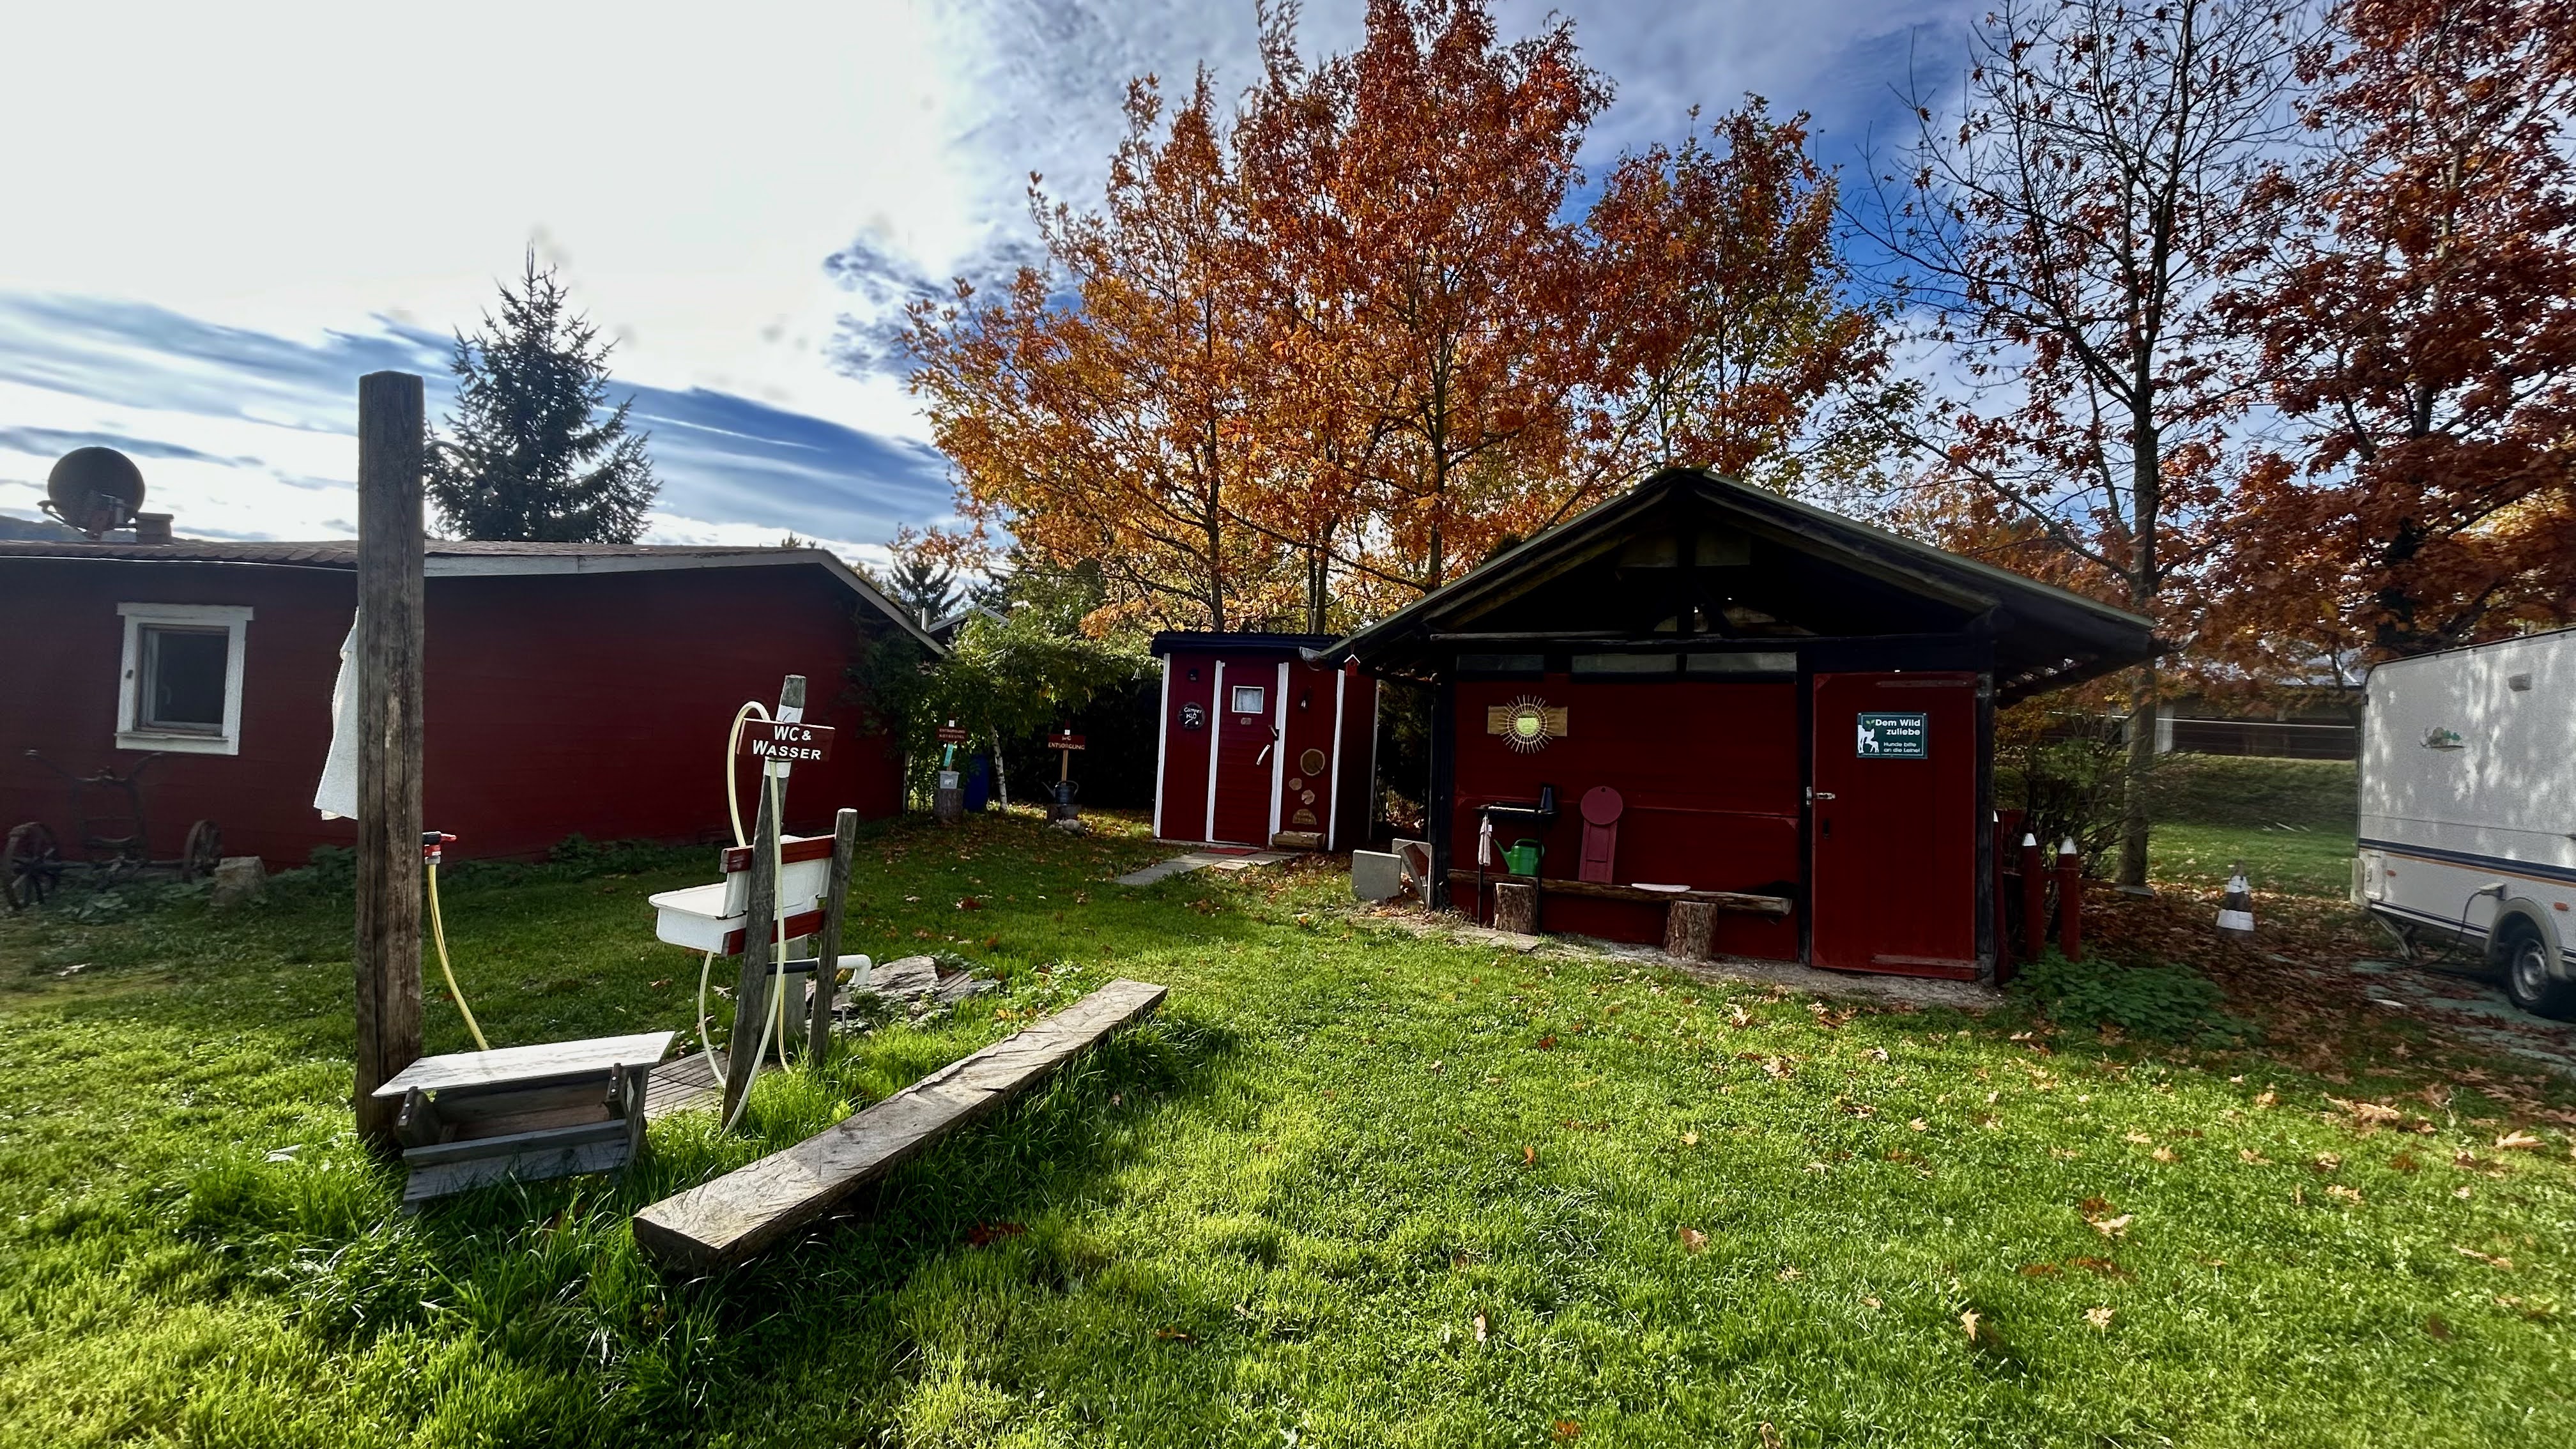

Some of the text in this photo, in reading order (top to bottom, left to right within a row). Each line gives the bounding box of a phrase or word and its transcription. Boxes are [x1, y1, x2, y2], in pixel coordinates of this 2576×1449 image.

[774, 726, 811, 741] WC &
[753, 739, 822, 760] WASSER
[1048, 742, 1085, 750] ENTSORGUNG
